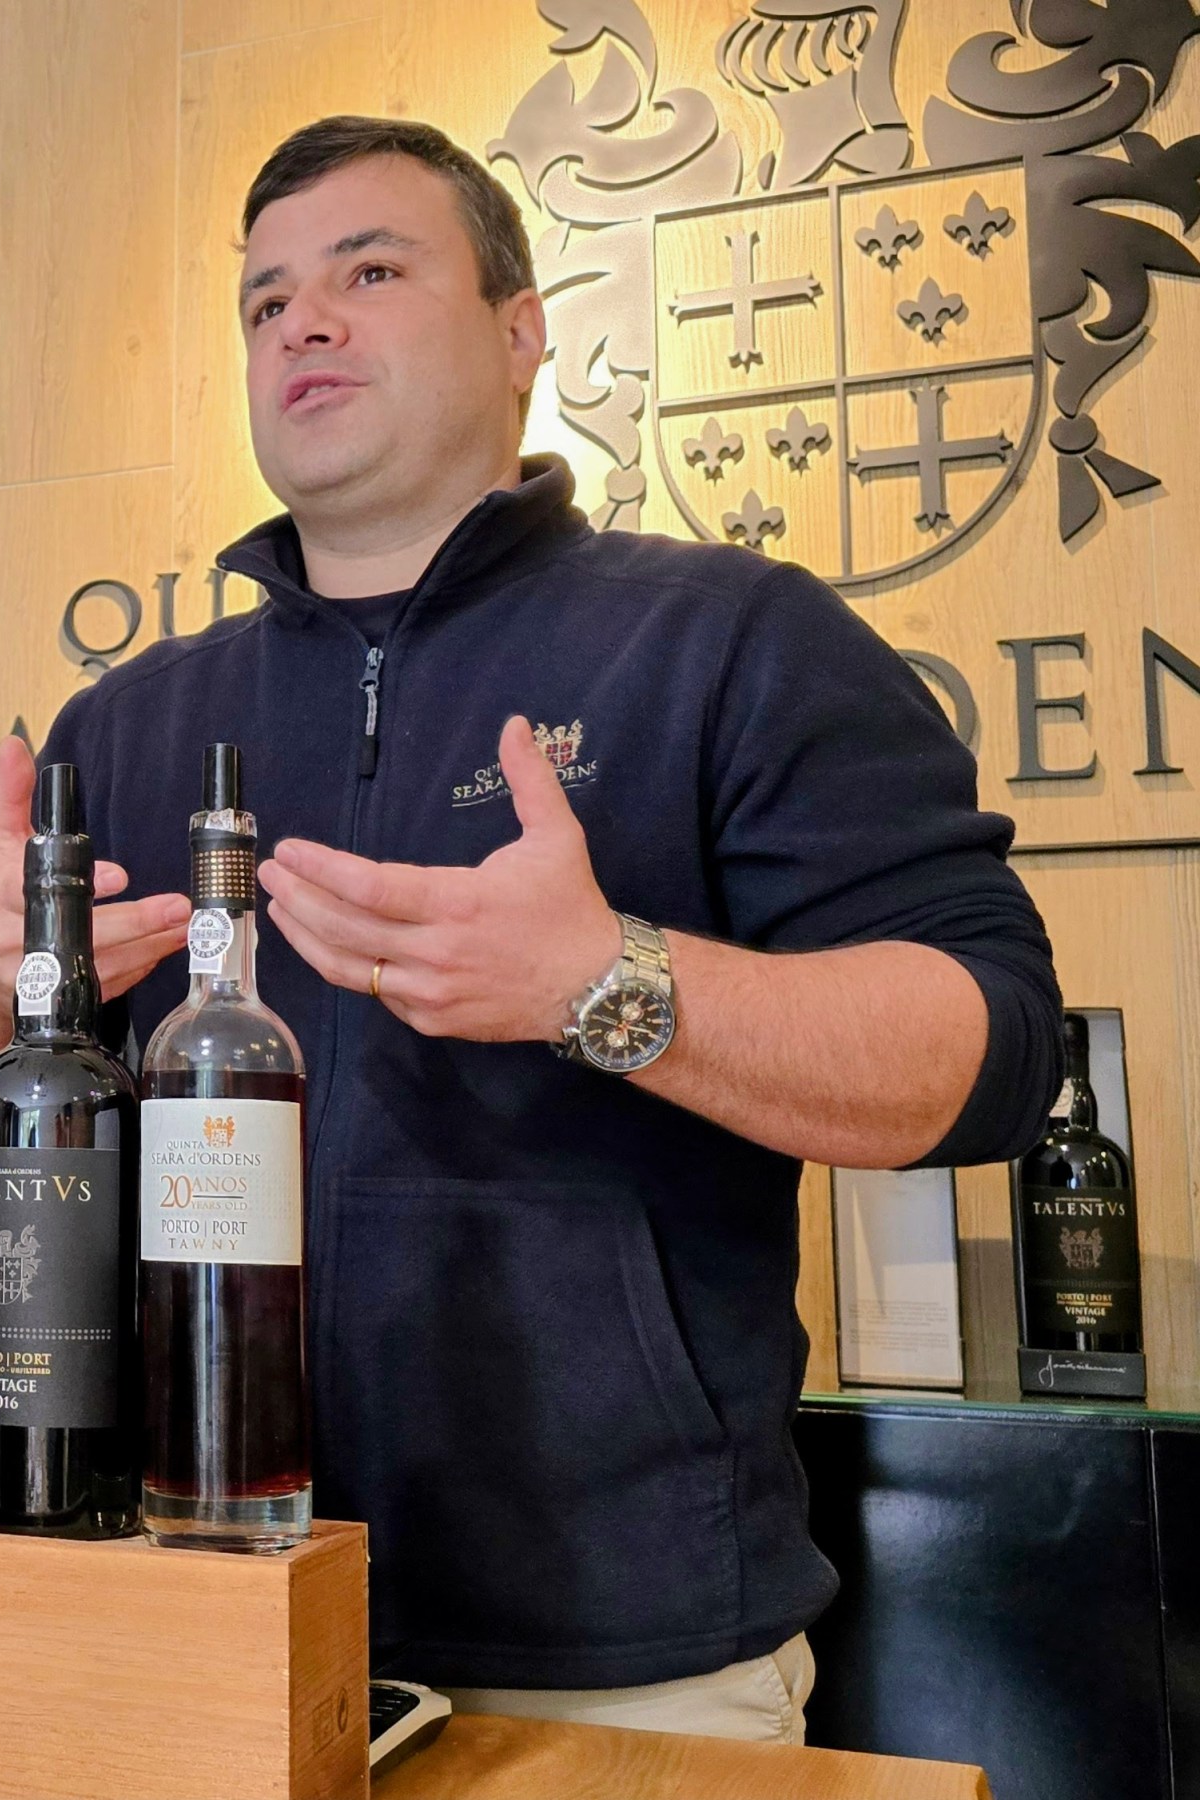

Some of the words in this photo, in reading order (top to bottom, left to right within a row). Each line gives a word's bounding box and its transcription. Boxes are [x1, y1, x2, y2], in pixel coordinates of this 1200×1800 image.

[166, 1140, 205, 1151] QUINTA
[151, 1152, 185, 1165] SEARA
[188, 1152, 261, 1167] d'ORDENS
[160, 1175, 192, 1209] 20
[192, 1176, 248, 1193] ANOS
[192, 1202, 221, 1210] YEARS
[225, 1201, 248, 1211] OLD
[161, 1219, 200, 1234] PORTO
[212, 1220, 248, 1235] PORT
[168, 1237, 238, 1251] TAWNY
[1056, 1292, 1084, 1301] PORTO
[1090, 1293, 1112, 1302] PORT
[1064, 1306, 1106, 1316] VINTAGE
[14, 1352, 52, 1365] PORT
